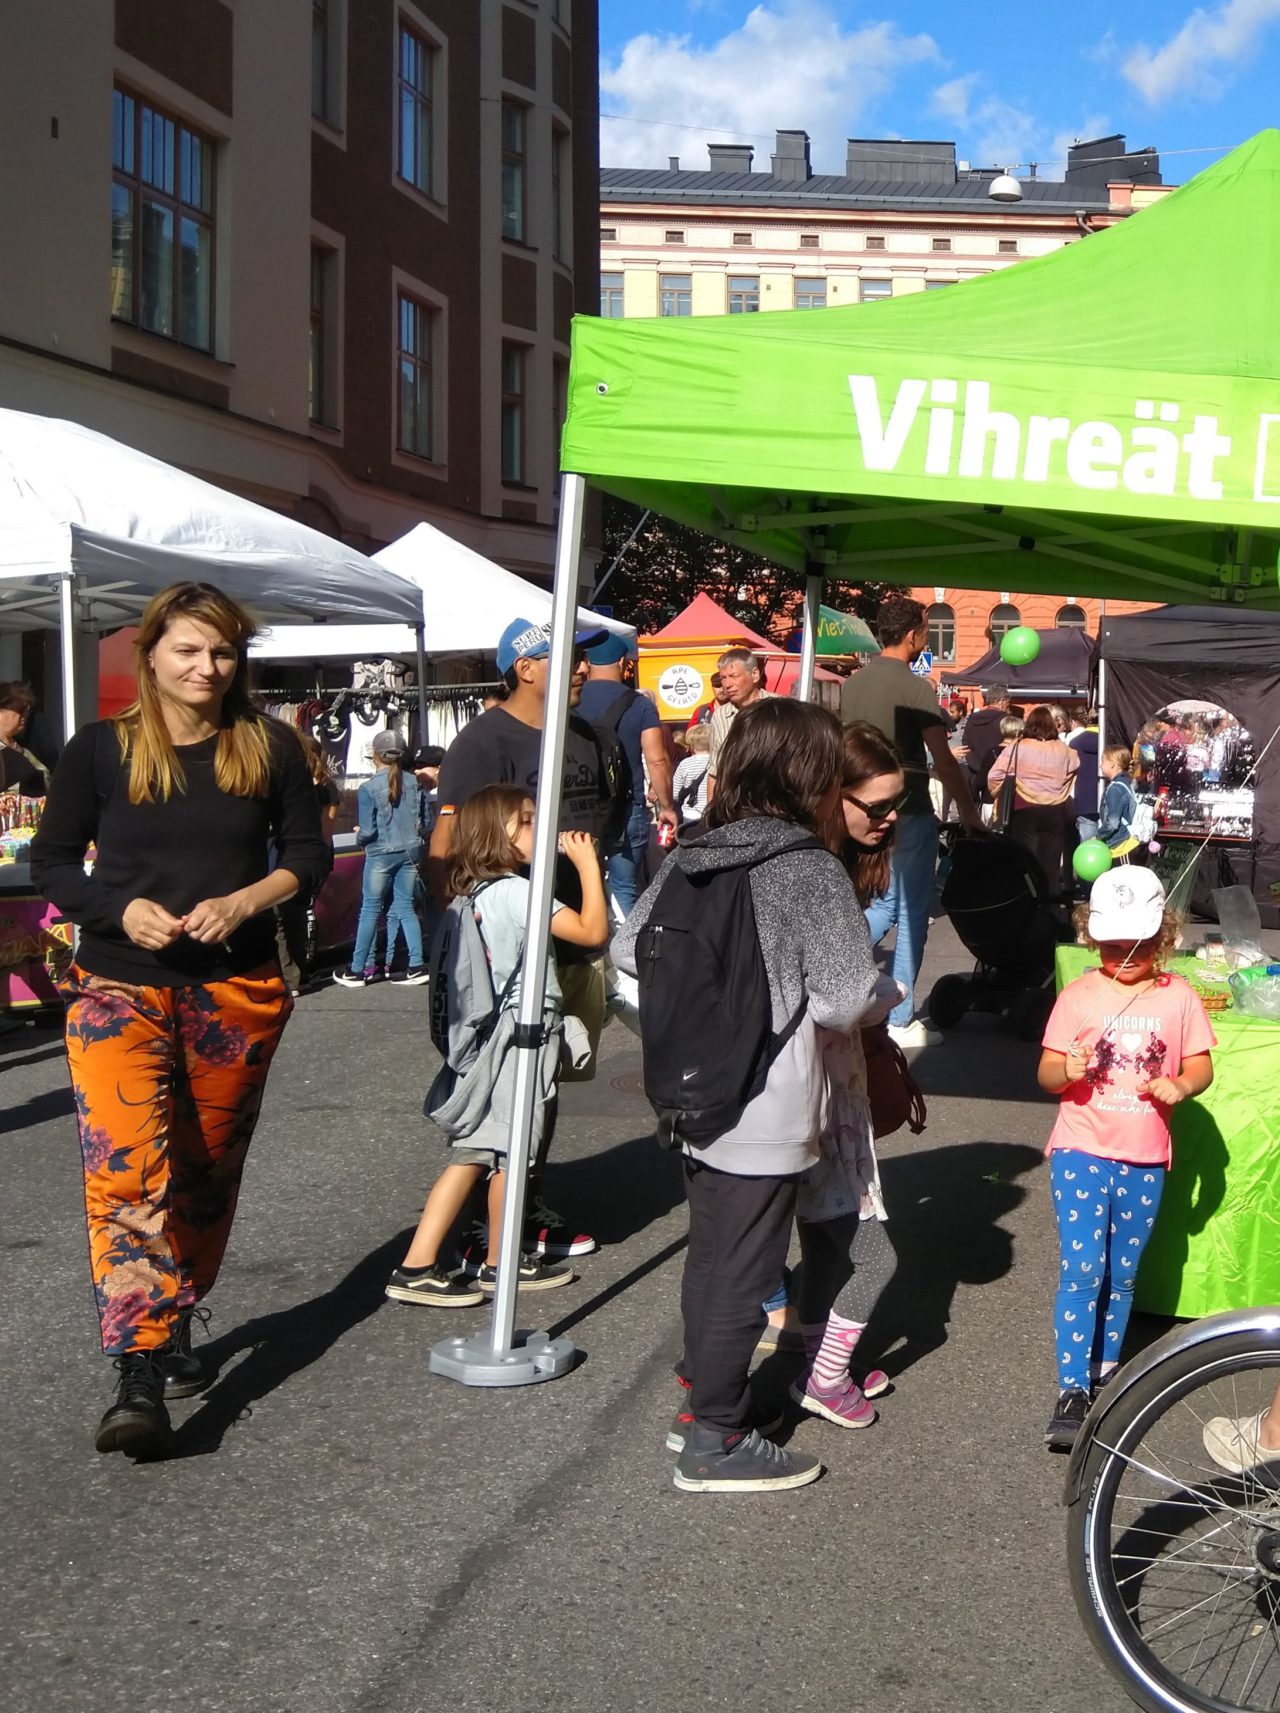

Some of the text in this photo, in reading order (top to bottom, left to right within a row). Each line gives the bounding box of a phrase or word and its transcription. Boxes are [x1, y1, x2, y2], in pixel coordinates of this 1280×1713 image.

[848, 374, 1232, 499] Vihreät
[513, 626, 540, 648] SURF
[518, 633, 543, 653] PERU
[672, 666, 688, 675] APE
[667, 692, 698, 705] GELATO
[1103, 1014, 1162, 1031] UNICORNS
[1085, 1475, 1103, 1617] SCHWALBE PLUS
